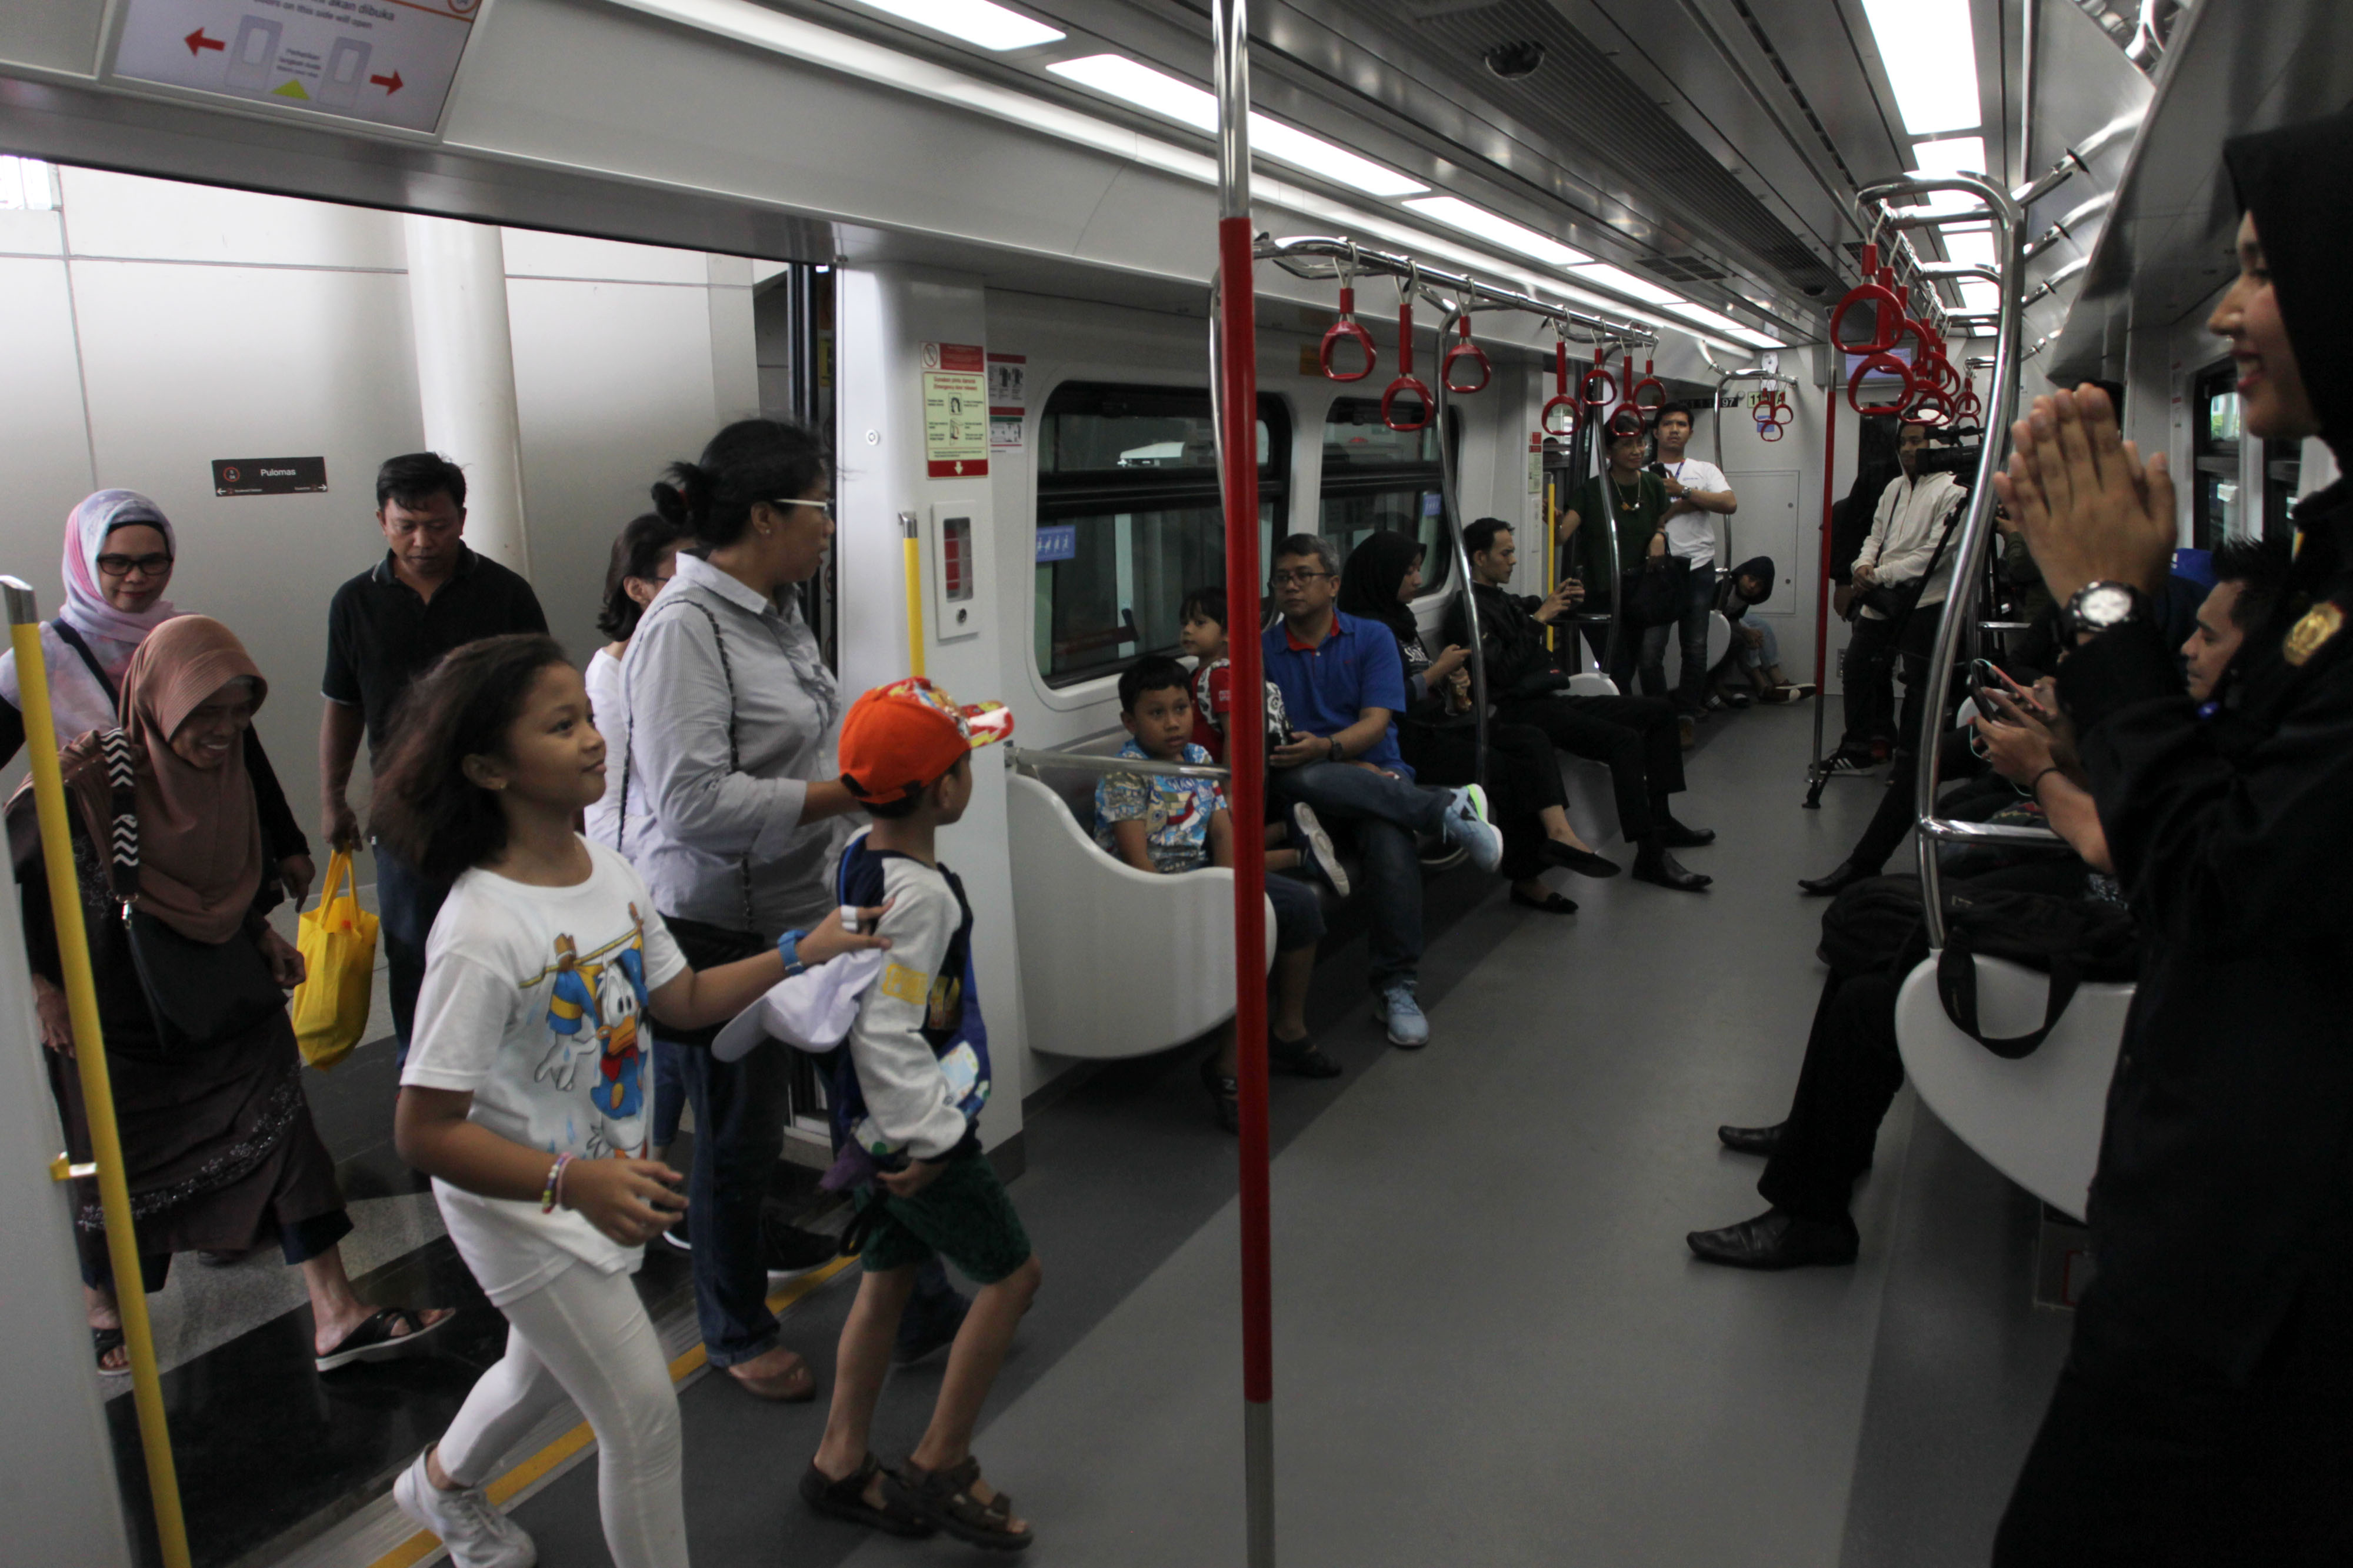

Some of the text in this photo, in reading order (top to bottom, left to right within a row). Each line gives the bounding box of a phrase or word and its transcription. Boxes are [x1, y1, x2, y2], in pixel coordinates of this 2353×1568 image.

[282, 2, 295, 10] on
[296, 5, 314, 15] this
[315, 9, 334, 19] side
[352, 18, 373, 29] open
[358, 4, 395, 21] dibuka
[1722, 398, 1734, 406] 97
